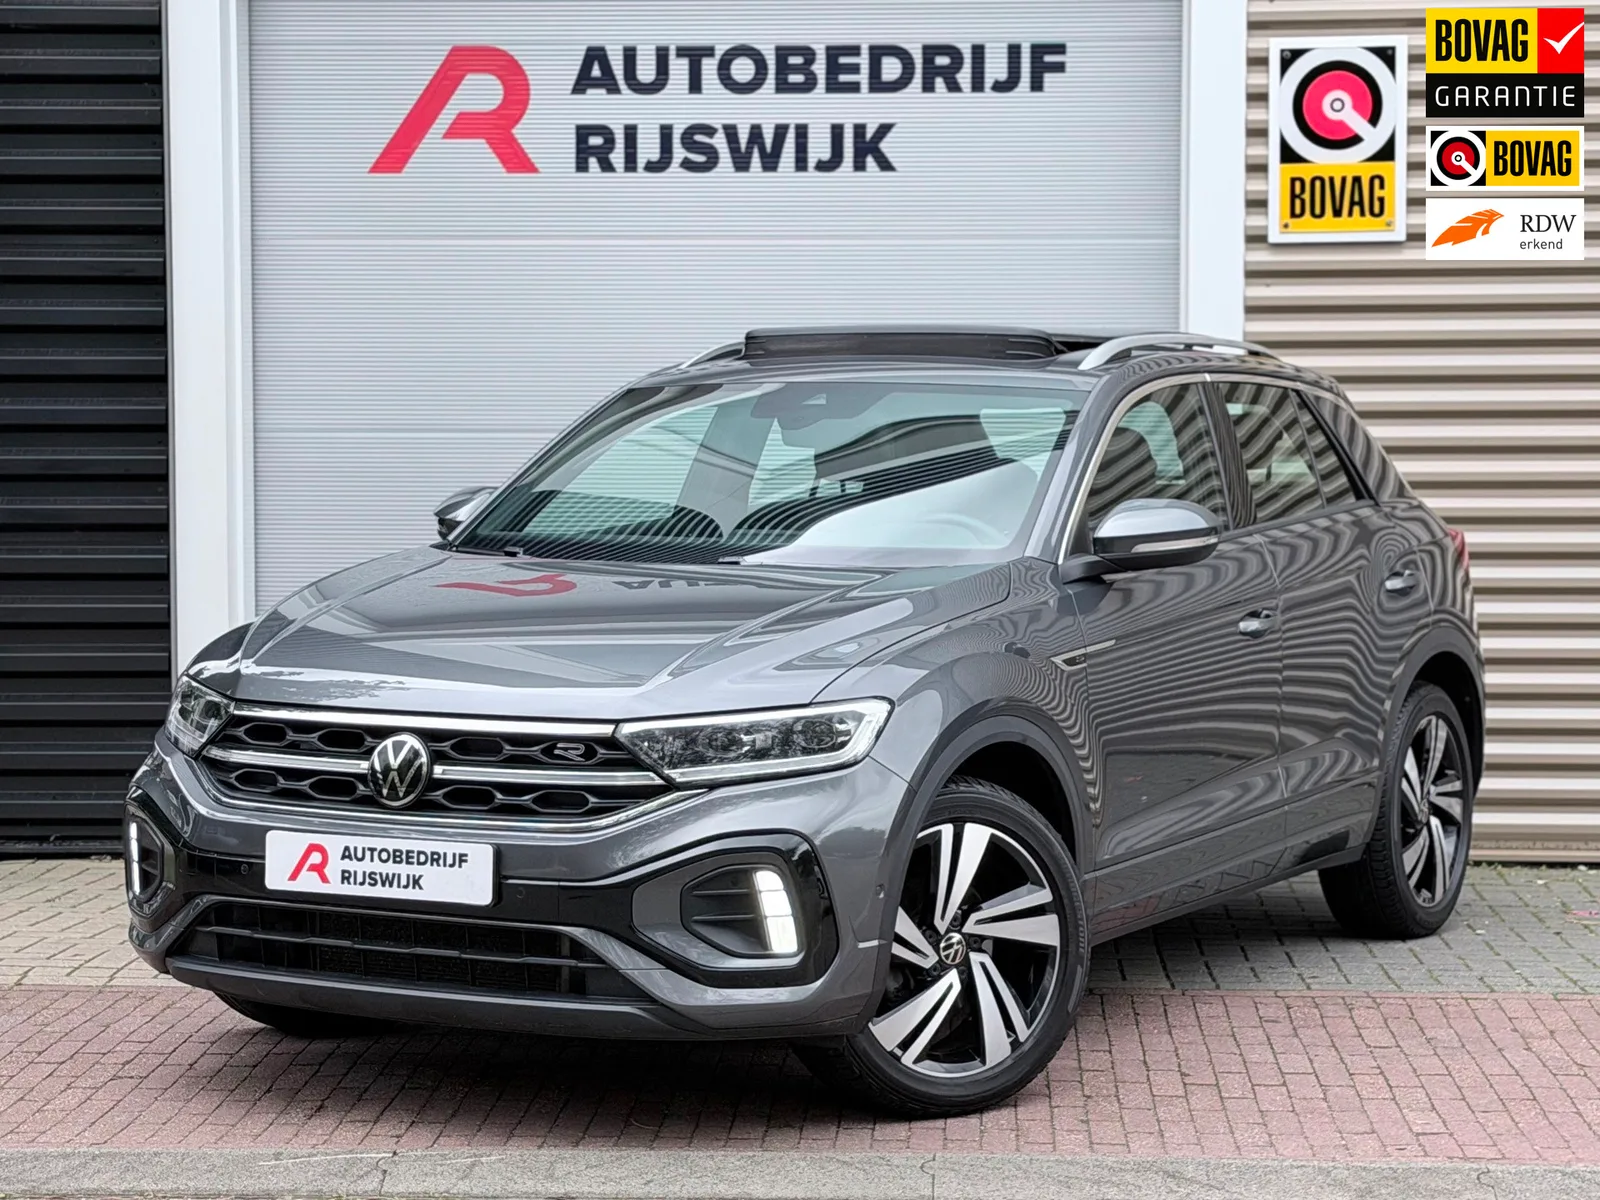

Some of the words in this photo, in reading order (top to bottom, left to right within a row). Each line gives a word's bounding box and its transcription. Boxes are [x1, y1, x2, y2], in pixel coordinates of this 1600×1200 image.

[570, 42, 1068, 96] AUTOBEDRIJF
[574, 122, 898, 174] RIJSWIJK
[1289, 174, 1386, 219] BOVAG
[340, 845, 469, 869] AUTOBEDRIJF
[340, 869, 424, 891] RIJSWIJK
